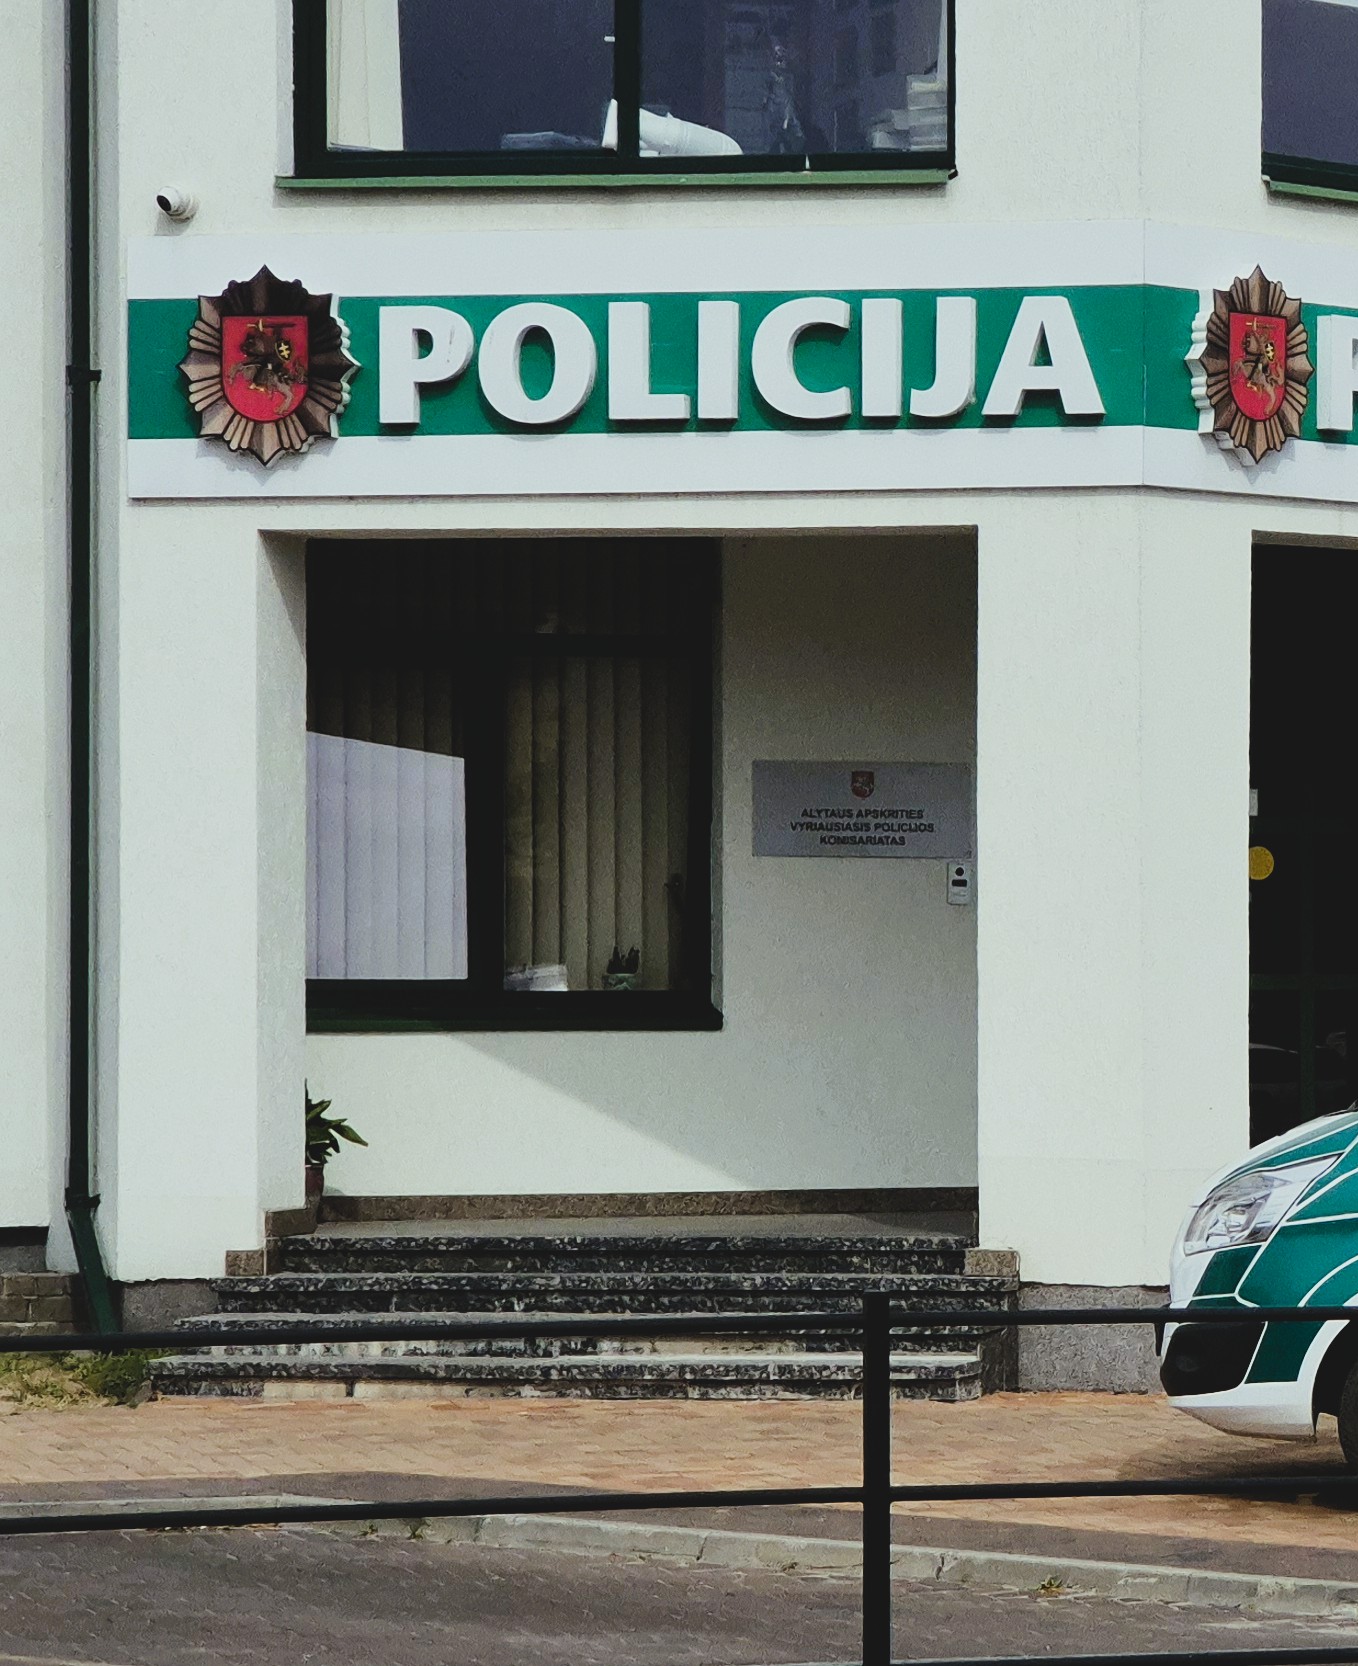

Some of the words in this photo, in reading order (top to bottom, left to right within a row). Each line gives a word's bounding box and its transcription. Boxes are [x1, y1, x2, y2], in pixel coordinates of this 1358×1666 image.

[377, 295, 1106, 425] POLICIJA
[801, 808, 853, 819] ALYTAUS
[856, 808, 924, 820] APSKRITIES
[790, 821, 872, 832] VYRIAUSIASIS
[874, 822, 934, 833] POLICIJOS
[819, 835, 906, 846] KOMISARIATAS
